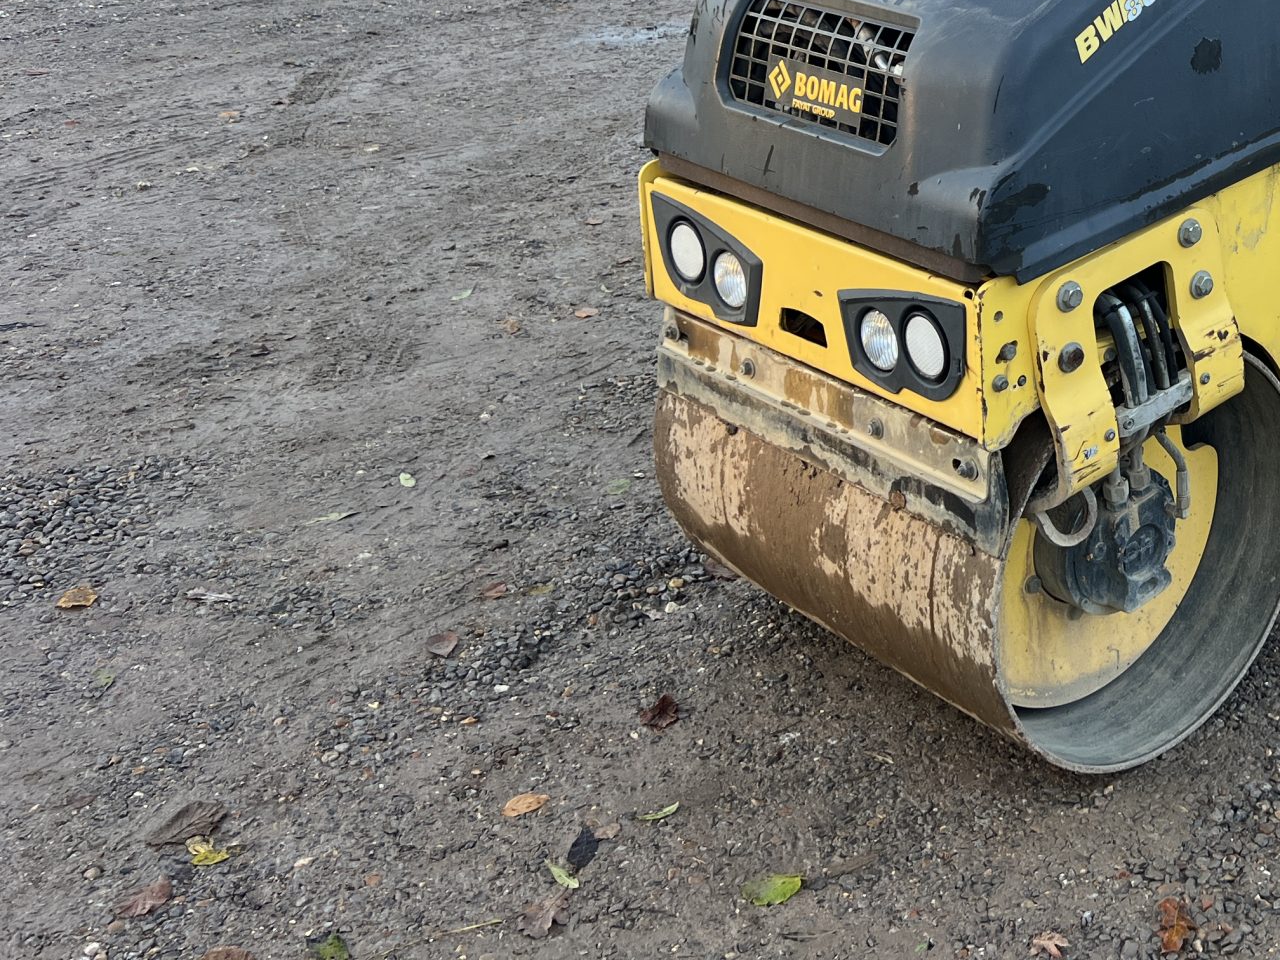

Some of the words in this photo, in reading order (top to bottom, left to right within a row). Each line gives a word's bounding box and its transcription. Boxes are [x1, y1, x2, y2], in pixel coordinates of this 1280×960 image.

[792, 97, 812, 112] FAYAT
[812, 104, 836, 119] GROUP
[794, 72, 863, 113] BOMAG
